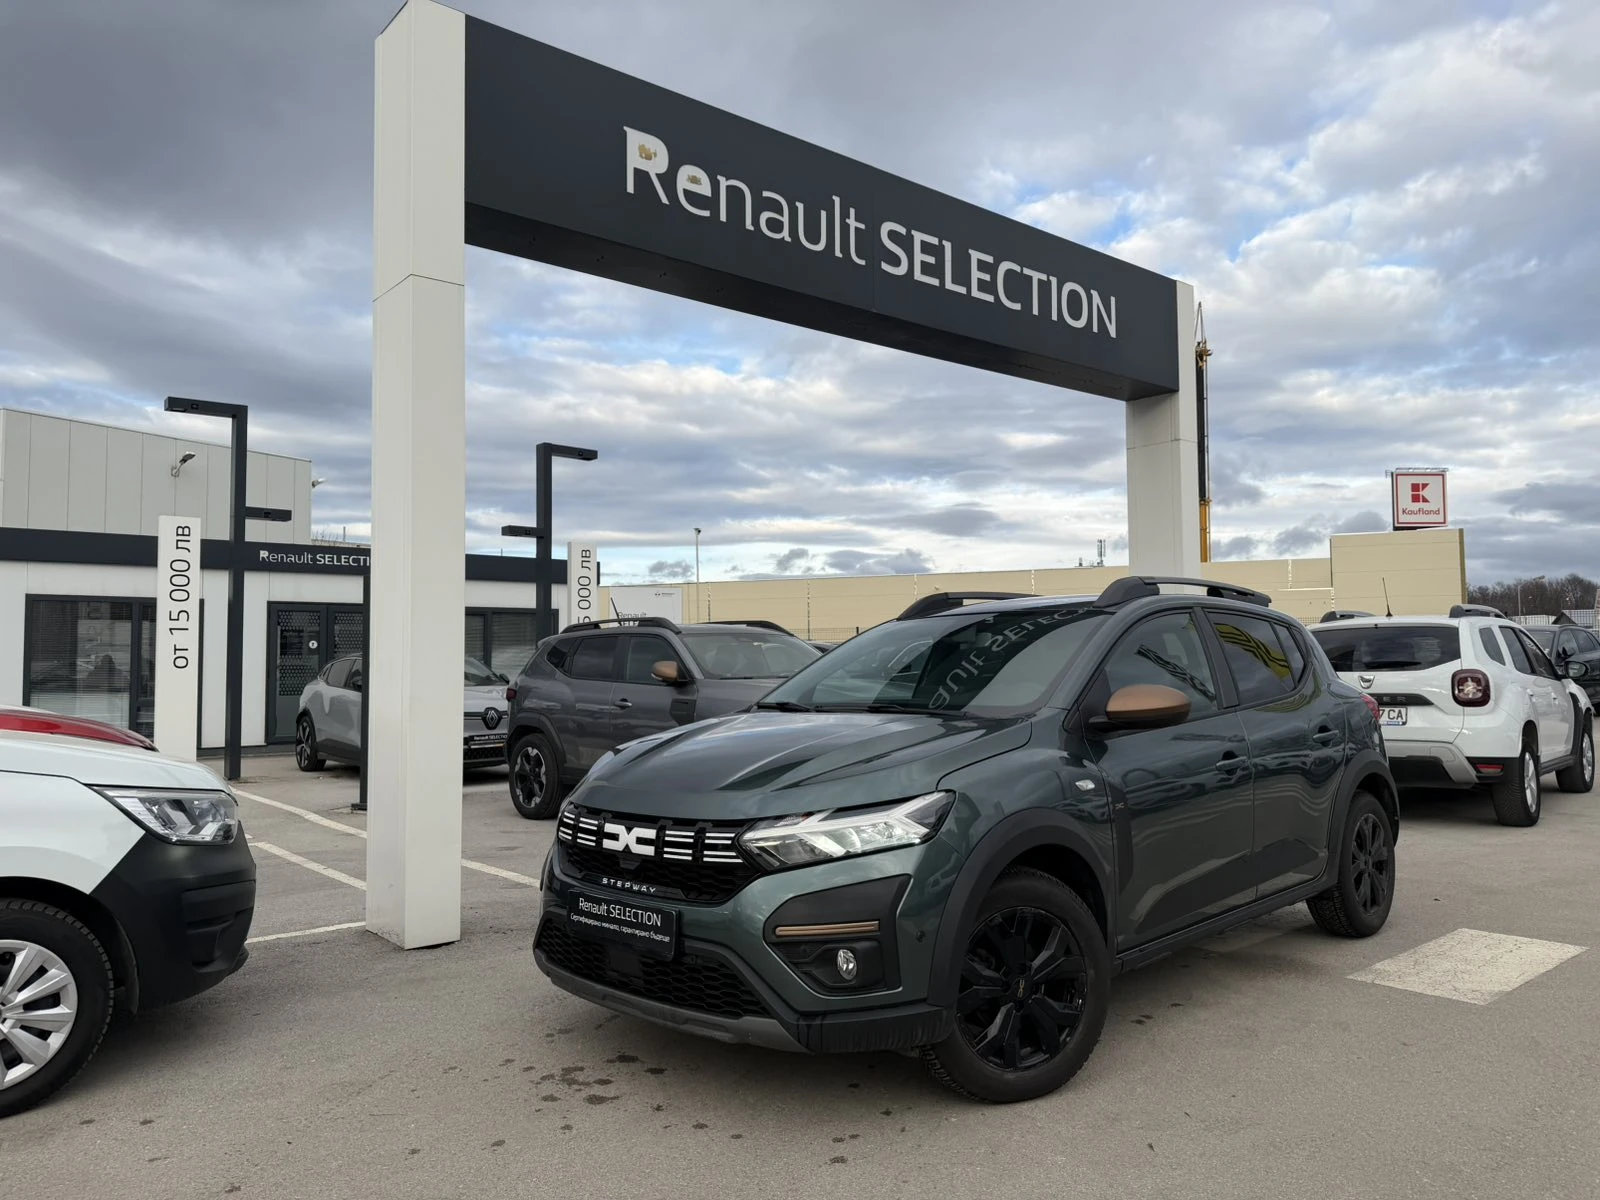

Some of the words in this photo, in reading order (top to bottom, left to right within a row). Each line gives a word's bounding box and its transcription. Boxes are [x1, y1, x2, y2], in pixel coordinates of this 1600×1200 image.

[623, 125, 867, 266] Renault
[879, 220, 1118, 339] SELECTION
[1402, 507, 1441, 516] Kaufland
[259, 549, 314, 565] Renault
[316, 553, 371, 567] SELECTI
[169, 559, 191, 602] 000
[577, 576, 592, 610] 000
[169, 609, 190, 635] 15
[601, 877, 656, 893] STEPWAY
[578, 897, 608, 917] Renault
[609, 904, 662, 927] SELECTION
